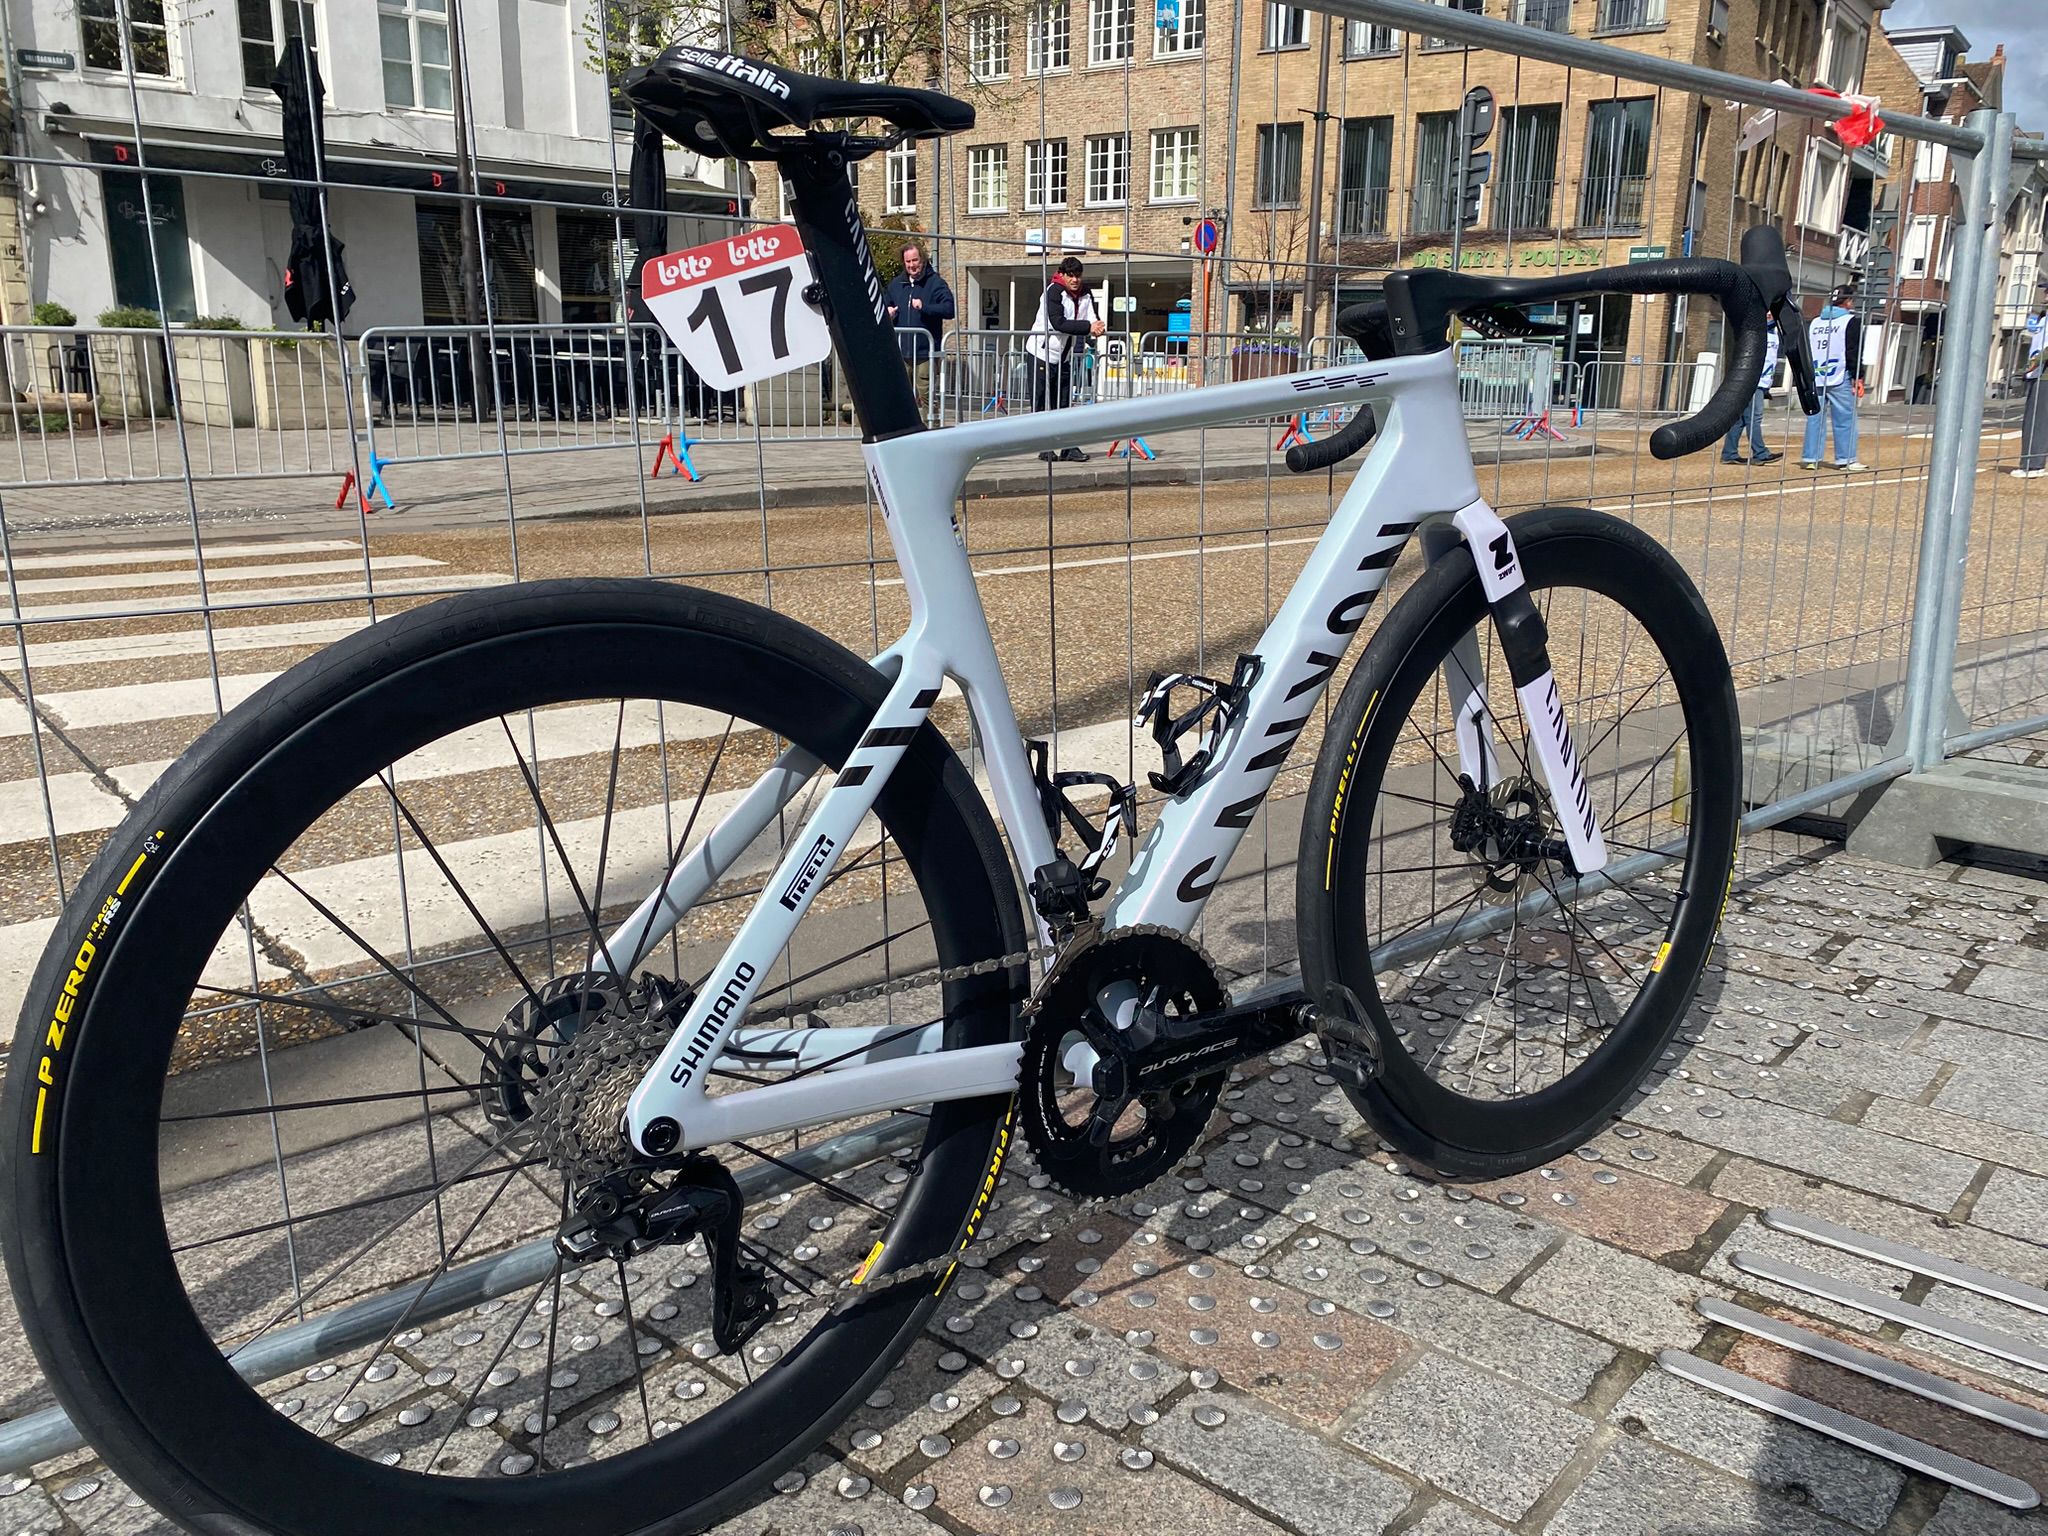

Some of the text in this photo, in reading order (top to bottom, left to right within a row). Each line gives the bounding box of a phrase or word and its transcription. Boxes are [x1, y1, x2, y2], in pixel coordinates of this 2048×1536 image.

[676, 48, 791, 100] selle italia
[657, 235, 780, 286] lotto lotto
[845, 197, 885, 325] CANYON
[1412, 251, 1438, 268] DE
[1520, 248, 1603, 267] POUPEY
[687, 266, 794, 375] 17
[1812, 326, 1840, 335] CREW
[1817, 340, 1828, 350] 19
[1498, 563, 1516, 580] ZWIFT
[1330, 740, 1358, 834] PIRELLI
[1546, 677, 1596, 843] CANYON
[779, 833, 836, 912] PIRELLI
[103, 898, 122, 925] RS
[38, 895, 116, 1086] P ZERO RACE
[670, 961, 757, 1088] SHIMANO
[1139, 1037, 1239, 1076] DURA-ACE
[966, 1129, 1009, 1236] PIRELLI
